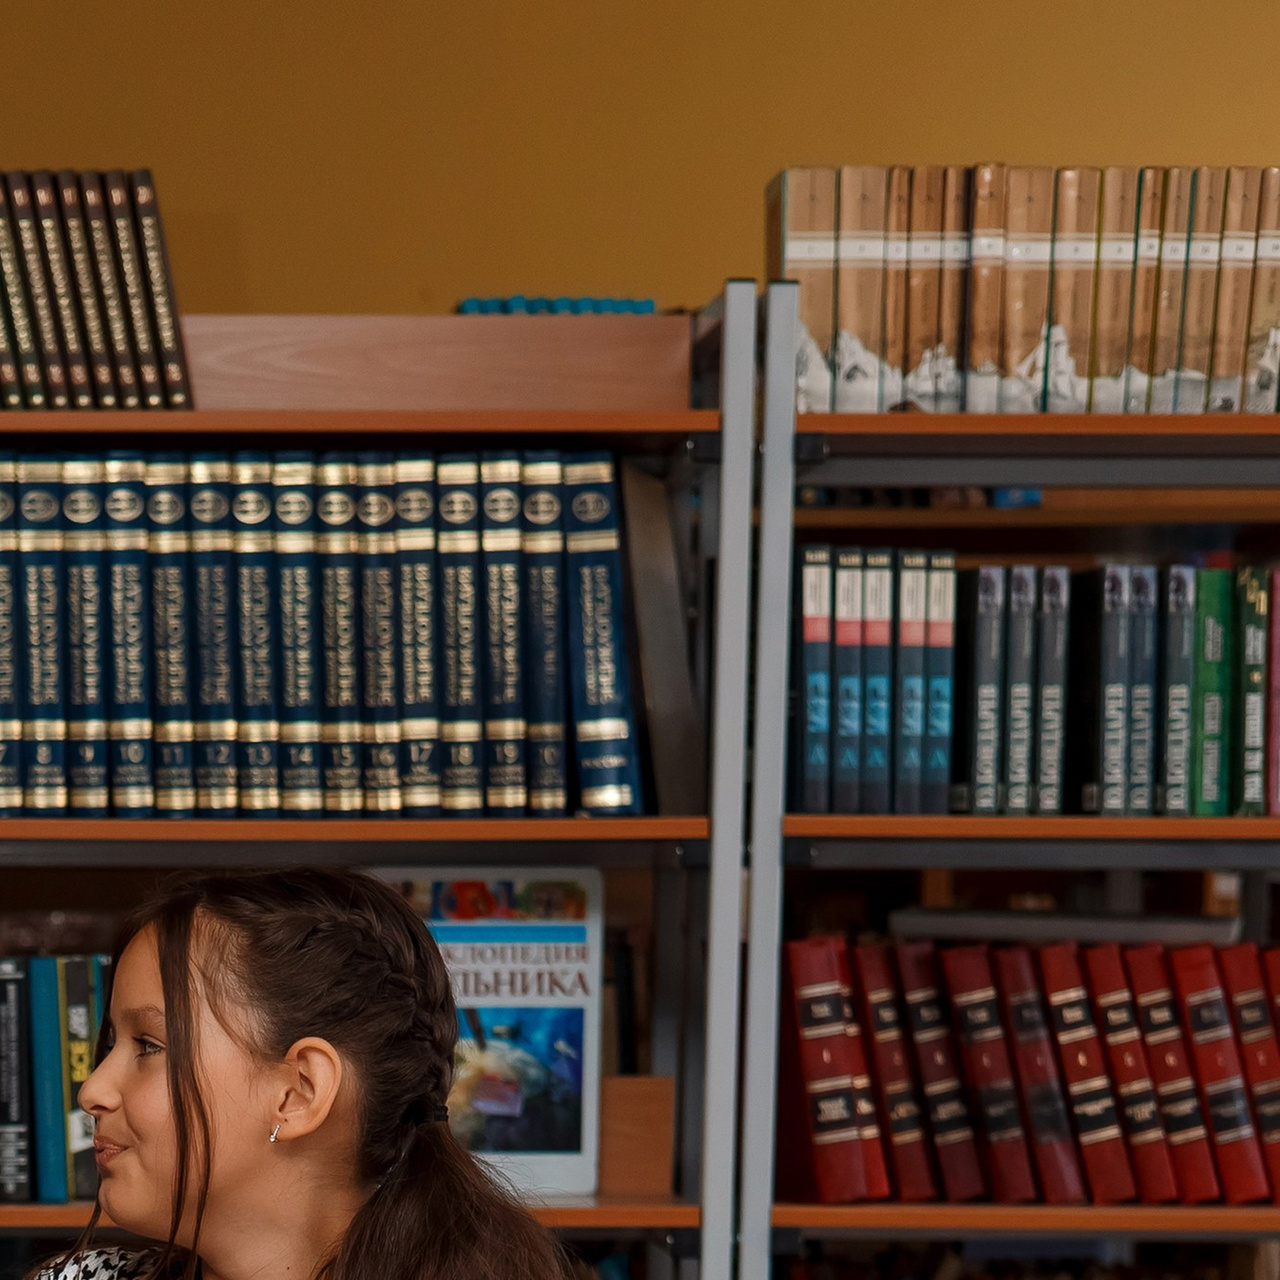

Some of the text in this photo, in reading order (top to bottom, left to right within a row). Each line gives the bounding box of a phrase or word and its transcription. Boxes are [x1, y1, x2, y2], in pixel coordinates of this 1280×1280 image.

[37, 743, 52, 764] 8
[119, 742, 144, 764] 10
[206, 744, 230, 764] 12
[248, 745, 271, 766] 13
[291, 745, 313, 765] 14
[332, 745, 355, 766] 15
[372, 744, 396, 766] 16
[410, 742, 434, 763] 17
[451, 744, 473, 766] 18
[496, 742, 518, 764] 19
